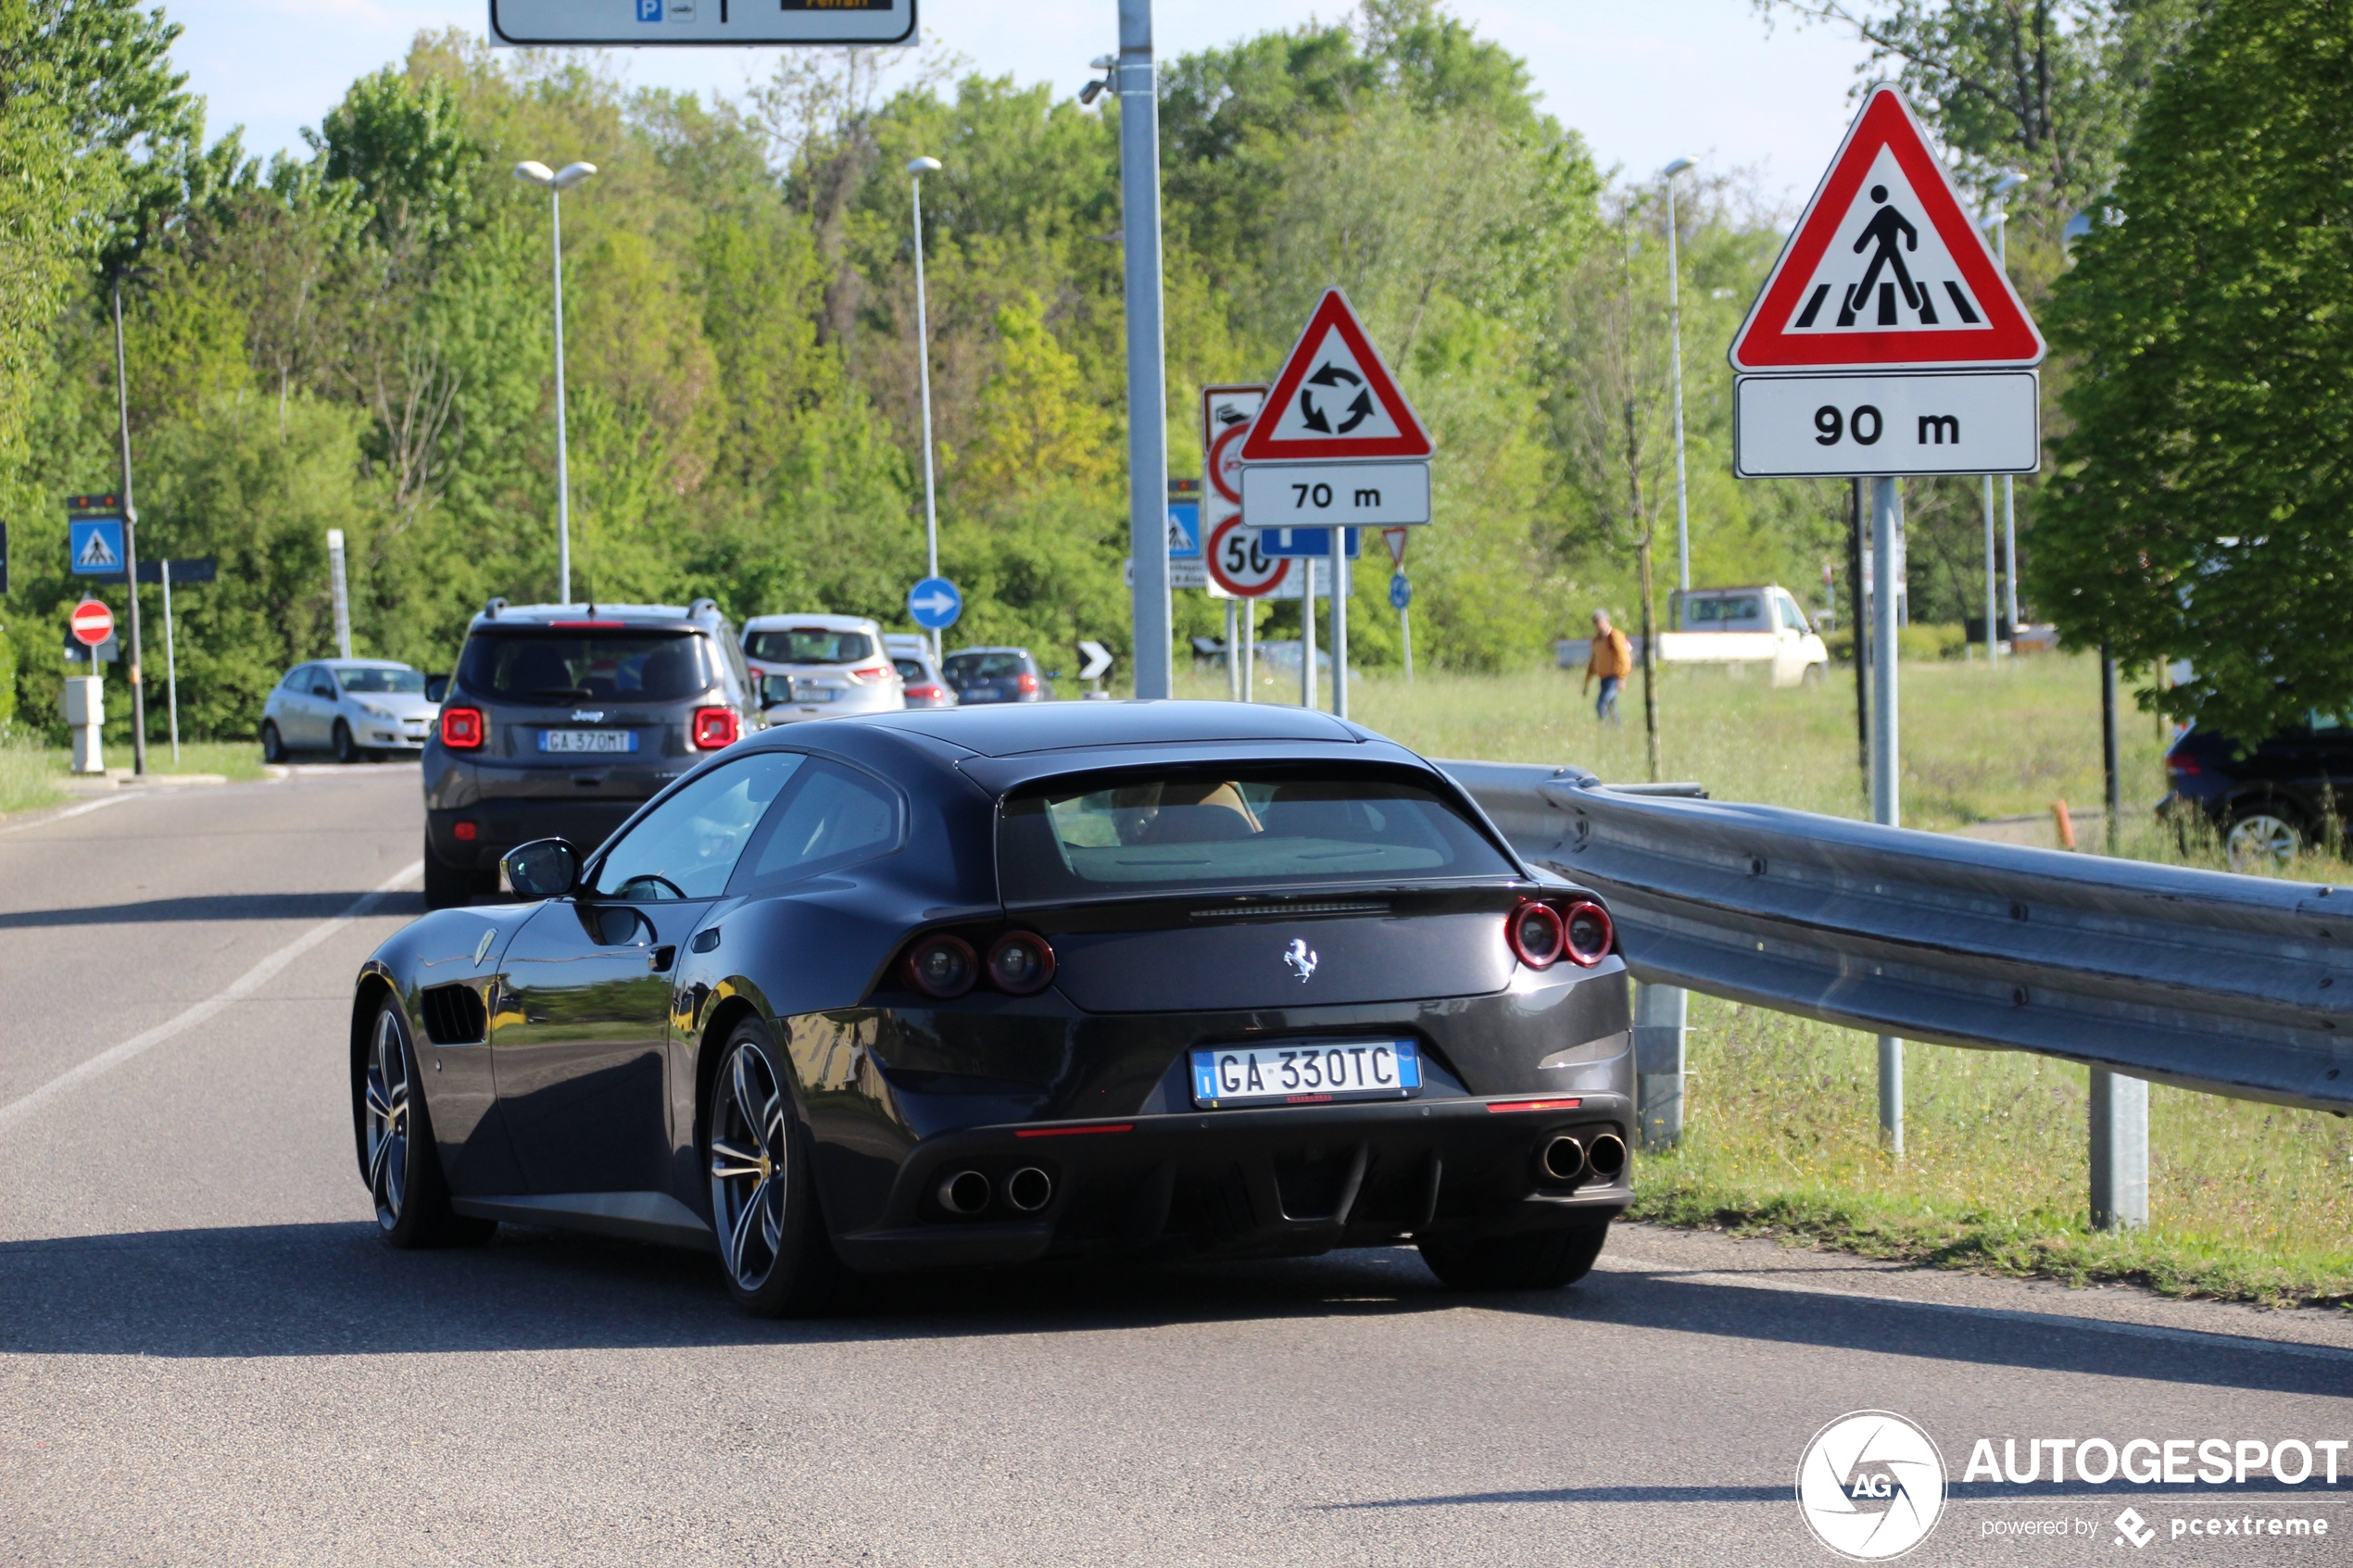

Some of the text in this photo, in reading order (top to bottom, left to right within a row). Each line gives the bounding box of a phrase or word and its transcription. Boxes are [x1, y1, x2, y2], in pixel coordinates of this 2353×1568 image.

[1815, 405, 1959, 445] 90 m
[1292, 483, 1380, 508] 70 m
[571, 709, 604, 722] Jeep
[1220, 1053, 1265, 1093] GA
[1278, 1047, 1392, 1089] 330TC
